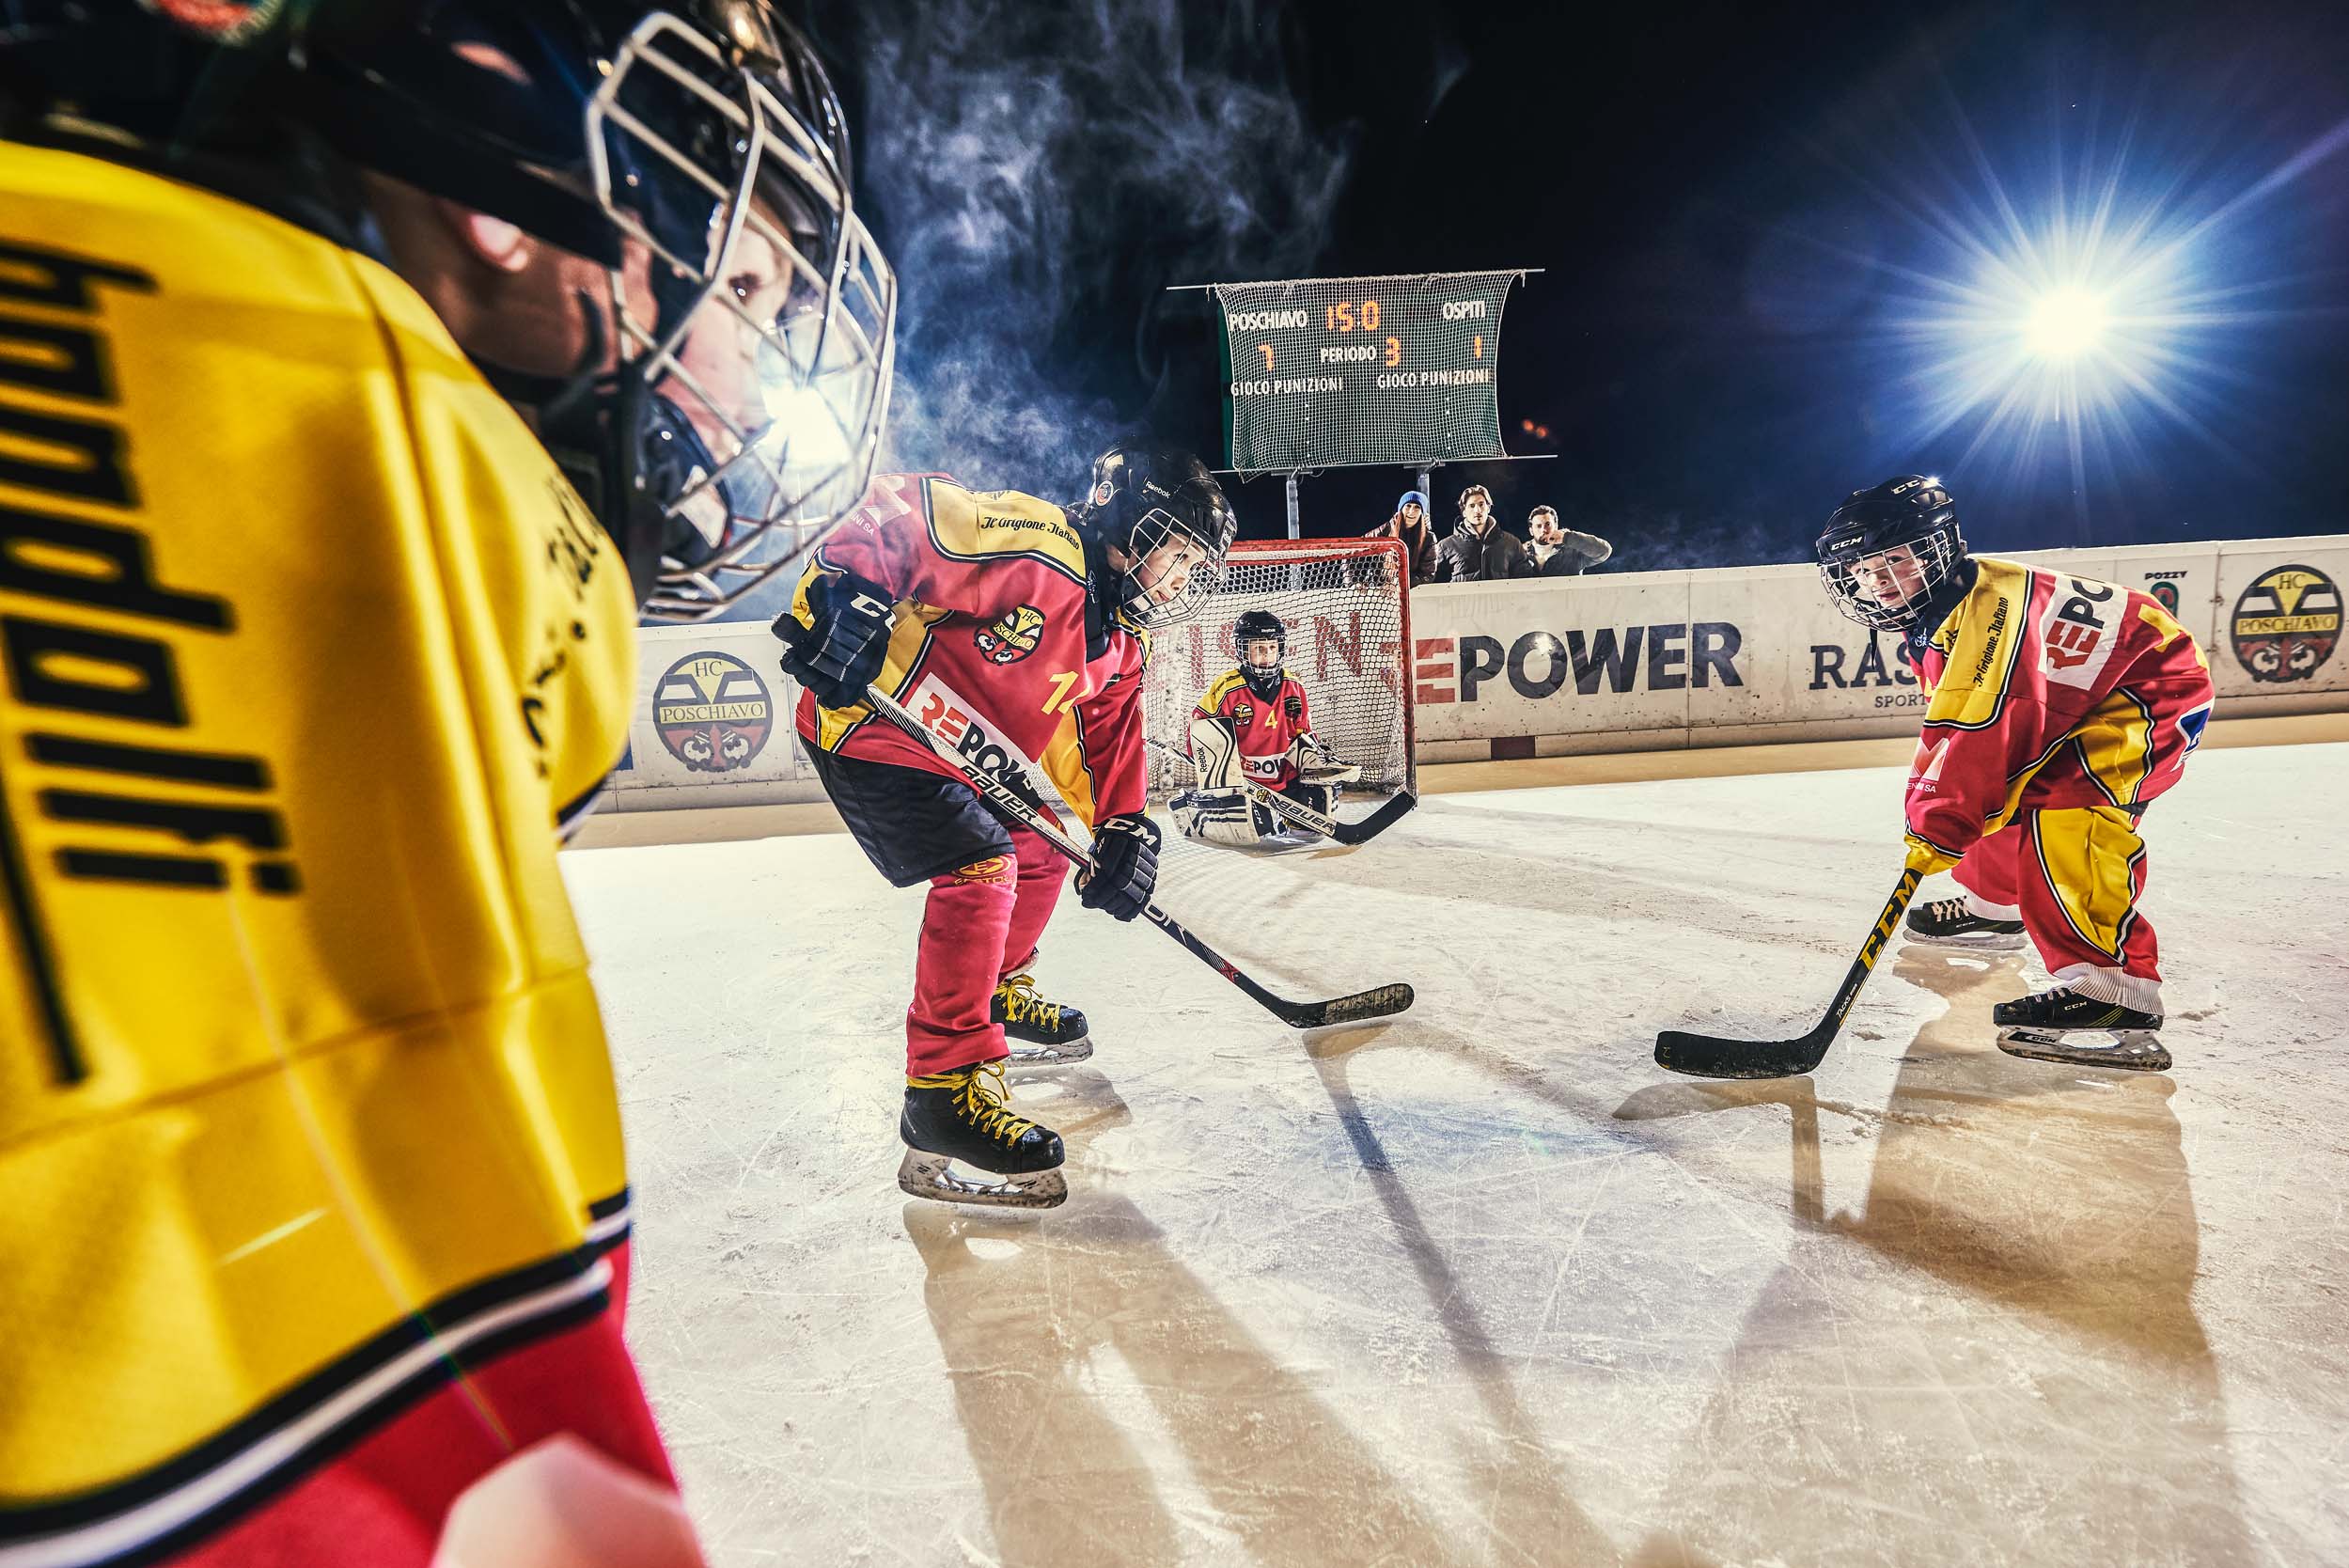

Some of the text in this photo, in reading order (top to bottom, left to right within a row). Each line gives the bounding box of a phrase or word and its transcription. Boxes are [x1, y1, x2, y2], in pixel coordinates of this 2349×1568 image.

[1443, 300, 1486, 320] OSPITI
[1229, 310, 1308, 331] POSCHIAVO
[1258, 342, 1275, 371] 7
[1320, 337, 1401, 368] PERIODO 3
[1474, 336, 1482, 359] 1
[1230, 377, 1343, 397] GIOCO PUNIZIONI
[1377, 368, 1489, 389] GIOCO PUNIZIONI
[1144, 480, 1171, 499] Reebok
[1892, 478, 1931, 495] CC
[1830, 536, 1863, 551] CCM
[2278, 574, 2305, 590] HC
[1022, 610, 1041, 624] HC
[2239, 615, 2337, 634] POSCHIAVO
[694, 661, 723, 677] HC
[1809, 641, 1919, 690] RAS
[662, 703, 764, 723] POSCHIAVO
[1264, 710, 1278, 729] 4
[1198, 746, 1209, 773] Reebok
[1924, 784, 1936, 793] SA
[1858, 872, 1918, 971] CCM
[2063, 1001, 2088, 1011] CCM
